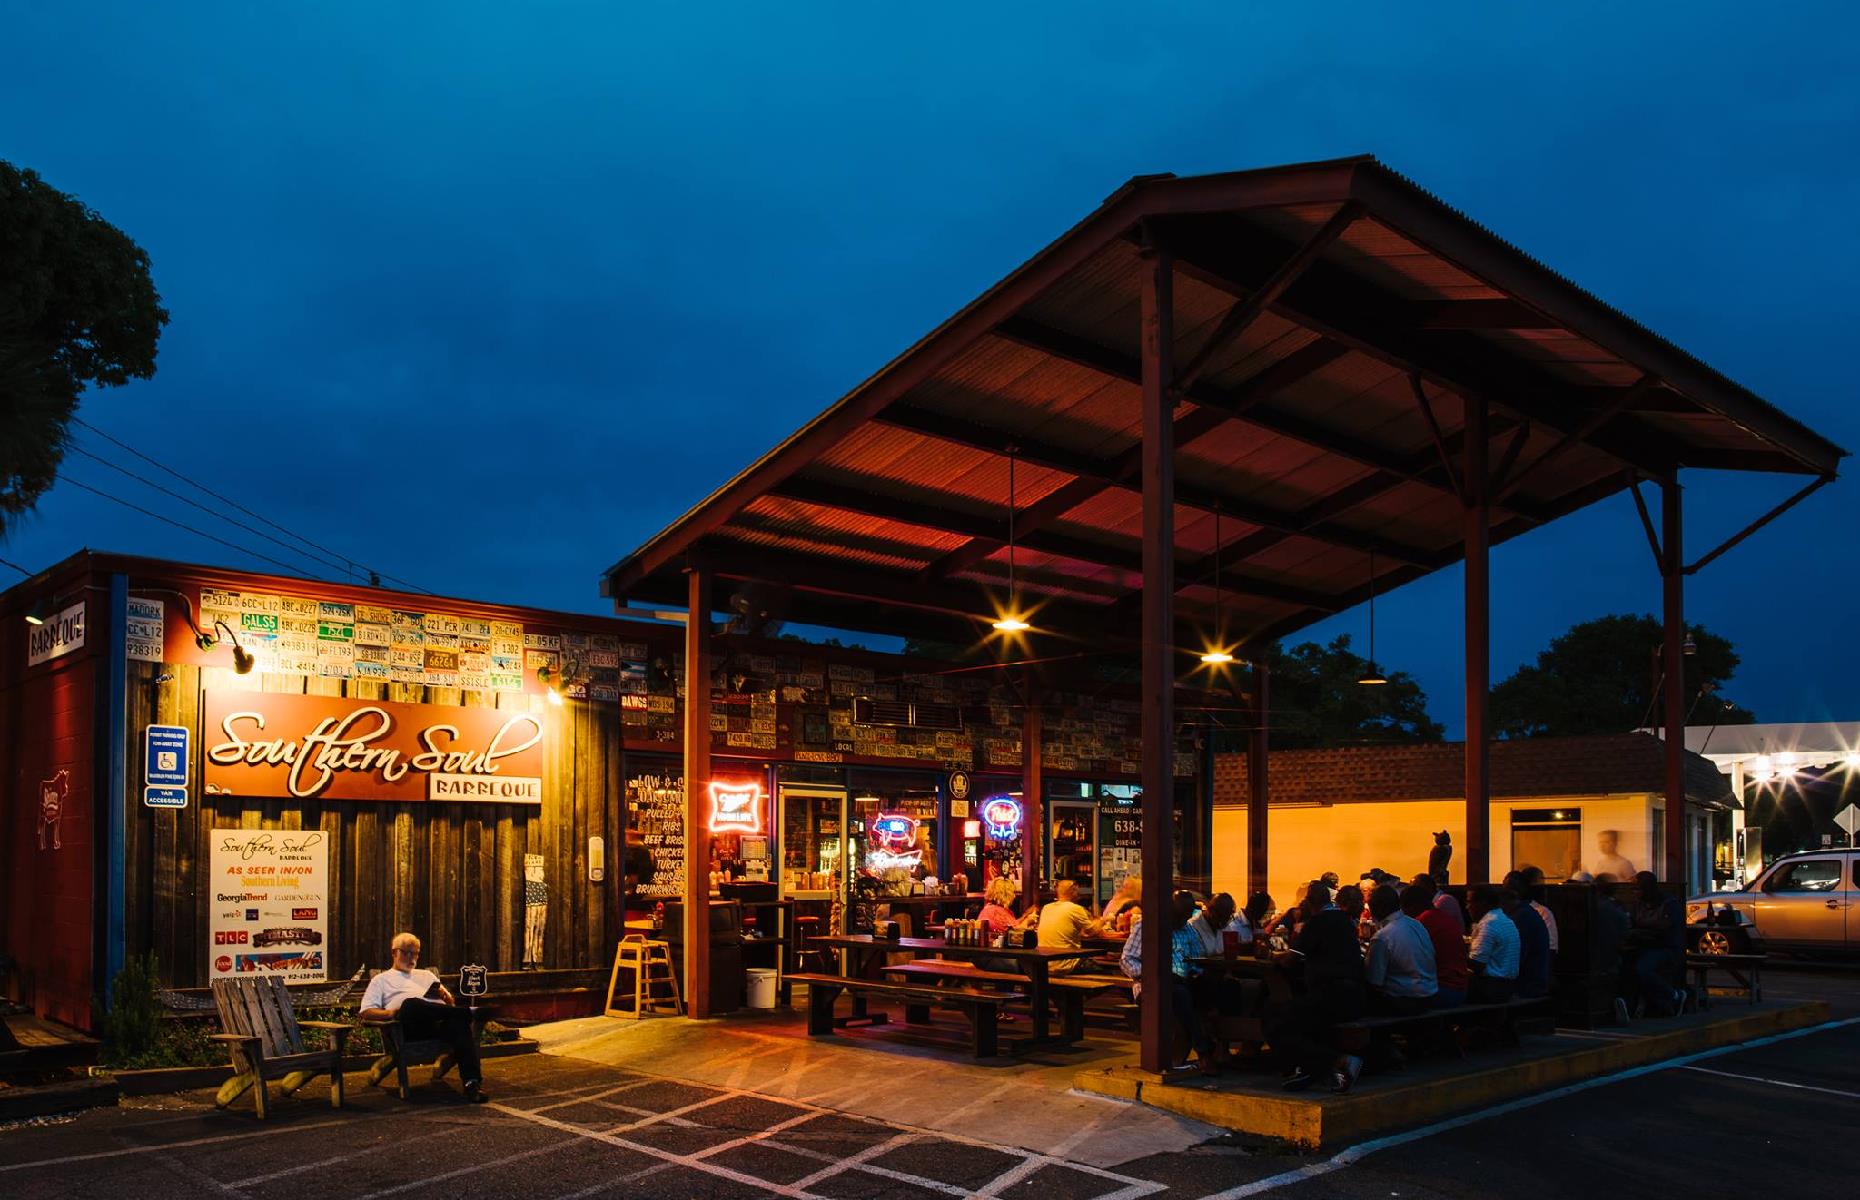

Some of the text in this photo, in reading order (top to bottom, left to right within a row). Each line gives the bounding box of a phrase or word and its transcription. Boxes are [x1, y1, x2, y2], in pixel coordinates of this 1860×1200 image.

[31, 611, 83, 657] BARBEQUE
[209, 705, 544, 798] Southern Soul
[436, 778, 537, 798] BARBEQUE
[220, 833, 322, 861] Southern Soul
[643, 834, 664, 845] BEEF
[227, 866, 313, 875] AS SEEN IN/ON
